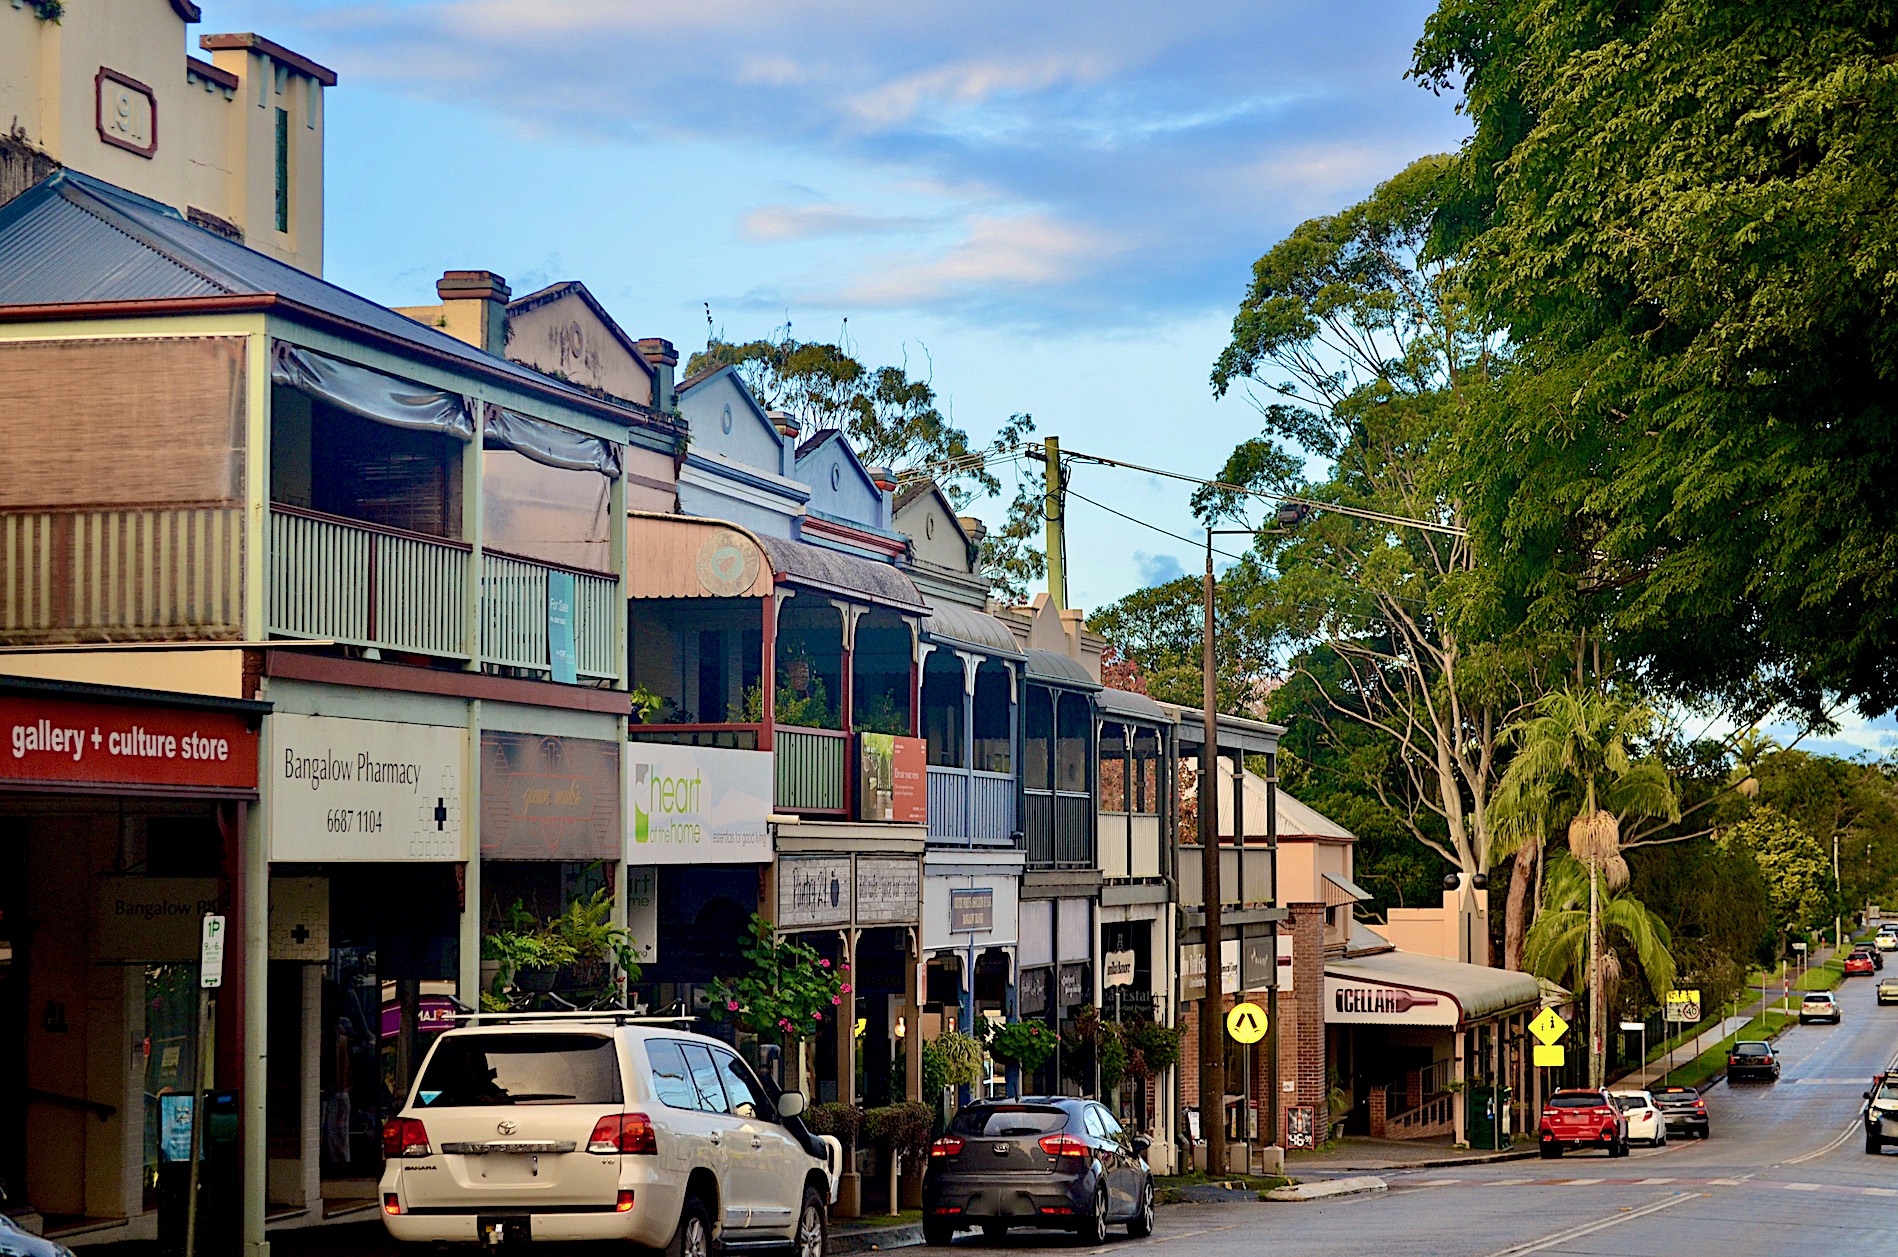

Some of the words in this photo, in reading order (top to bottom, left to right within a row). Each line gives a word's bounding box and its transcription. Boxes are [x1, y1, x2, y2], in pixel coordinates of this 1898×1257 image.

[12, 719, 85, 761] gallery
[91, 727, 103, 750] +
[108, 726, 177, 758] culture
[181, 730, 229, 761] store
[285, 748, 353, 790] Bangalow
[358, 751, 421, 794] Pharmacy
[650, 763, 702, 814] heart
[327, 809, 354, 833] 6687
[357, 810, 382, 833] 1104
[671, 817, 701, 844] home
[114, 900, 191, 920] Bangalow
[208, 919, 220, 938] 1P
[1123, 989, 1151, 1002] Estat
[1344, 988, 1395, 1013] CELLAR
